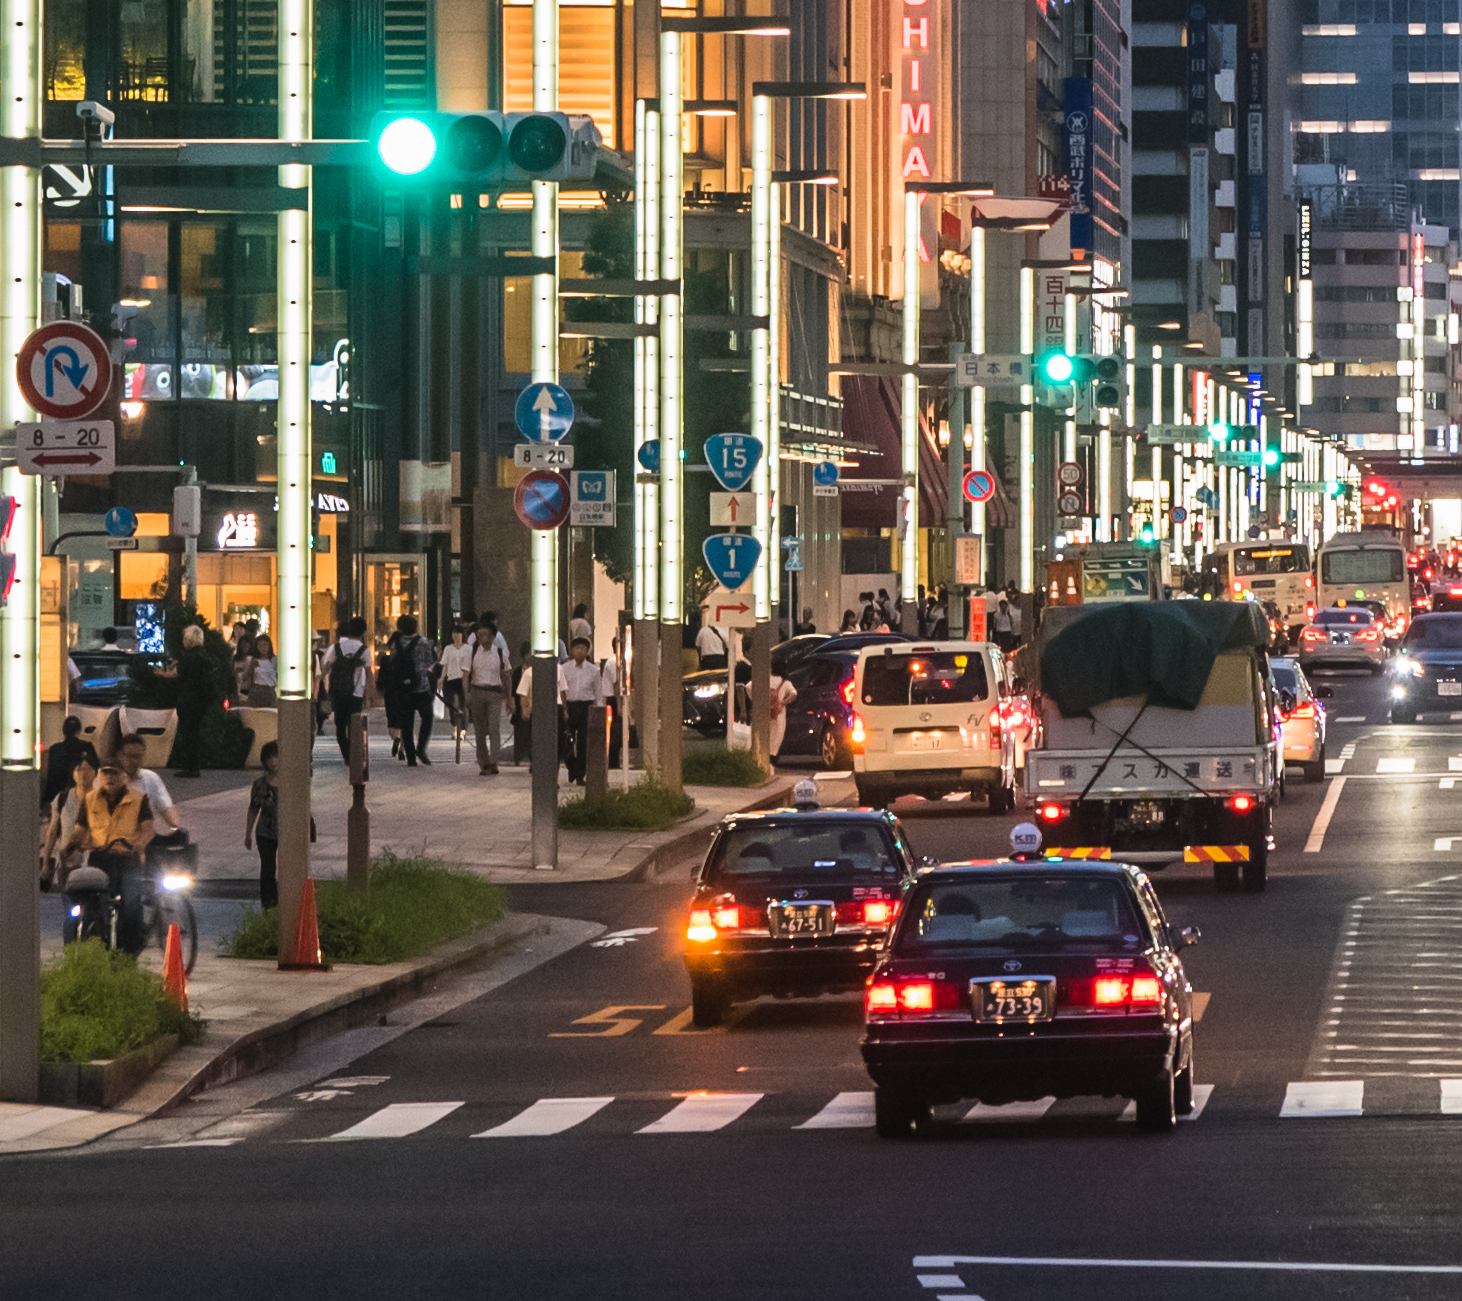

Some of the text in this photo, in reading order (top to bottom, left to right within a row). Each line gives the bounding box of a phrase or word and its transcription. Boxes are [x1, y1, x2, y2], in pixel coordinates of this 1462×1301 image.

[965, 362, 1023, 376] 日本橋
[722, 449, 747, 469] 15
[728, 549, 736, 569] 1
[788, 915, 823, 931] 67-51
[995, 999, 1042, 1016] 73-39
